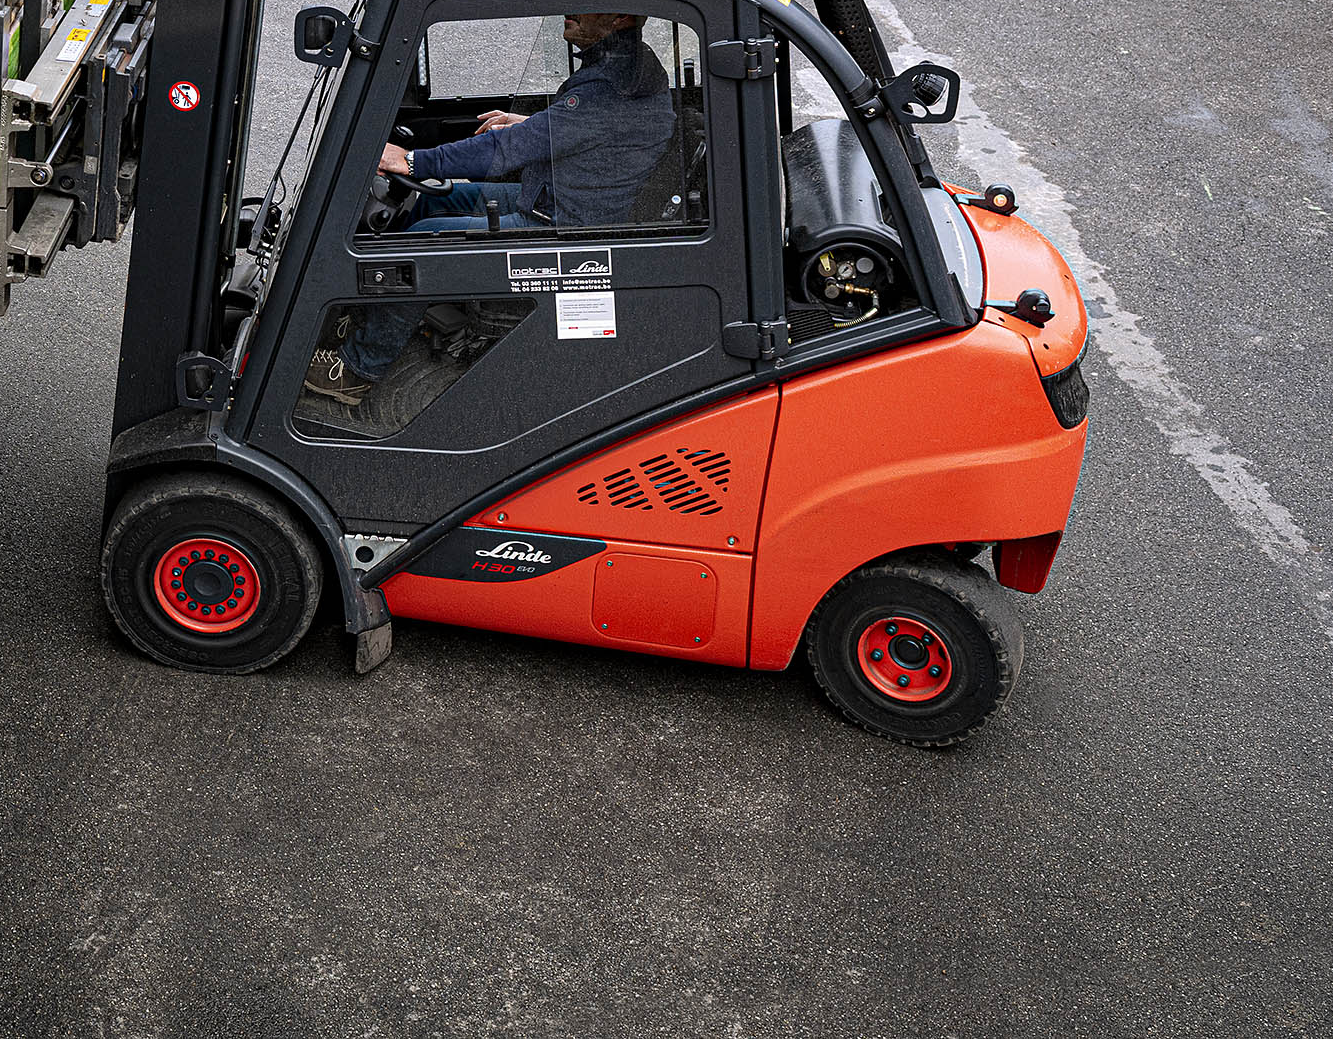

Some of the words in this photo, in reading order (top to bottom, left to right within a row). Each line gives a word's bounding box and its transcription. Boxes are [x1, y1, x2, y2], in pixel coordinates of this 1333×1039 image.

[511, 267, 558, 276] motrac
[569, 260, 609, 274] Linde
[475, 541, 552, 564] Linde
